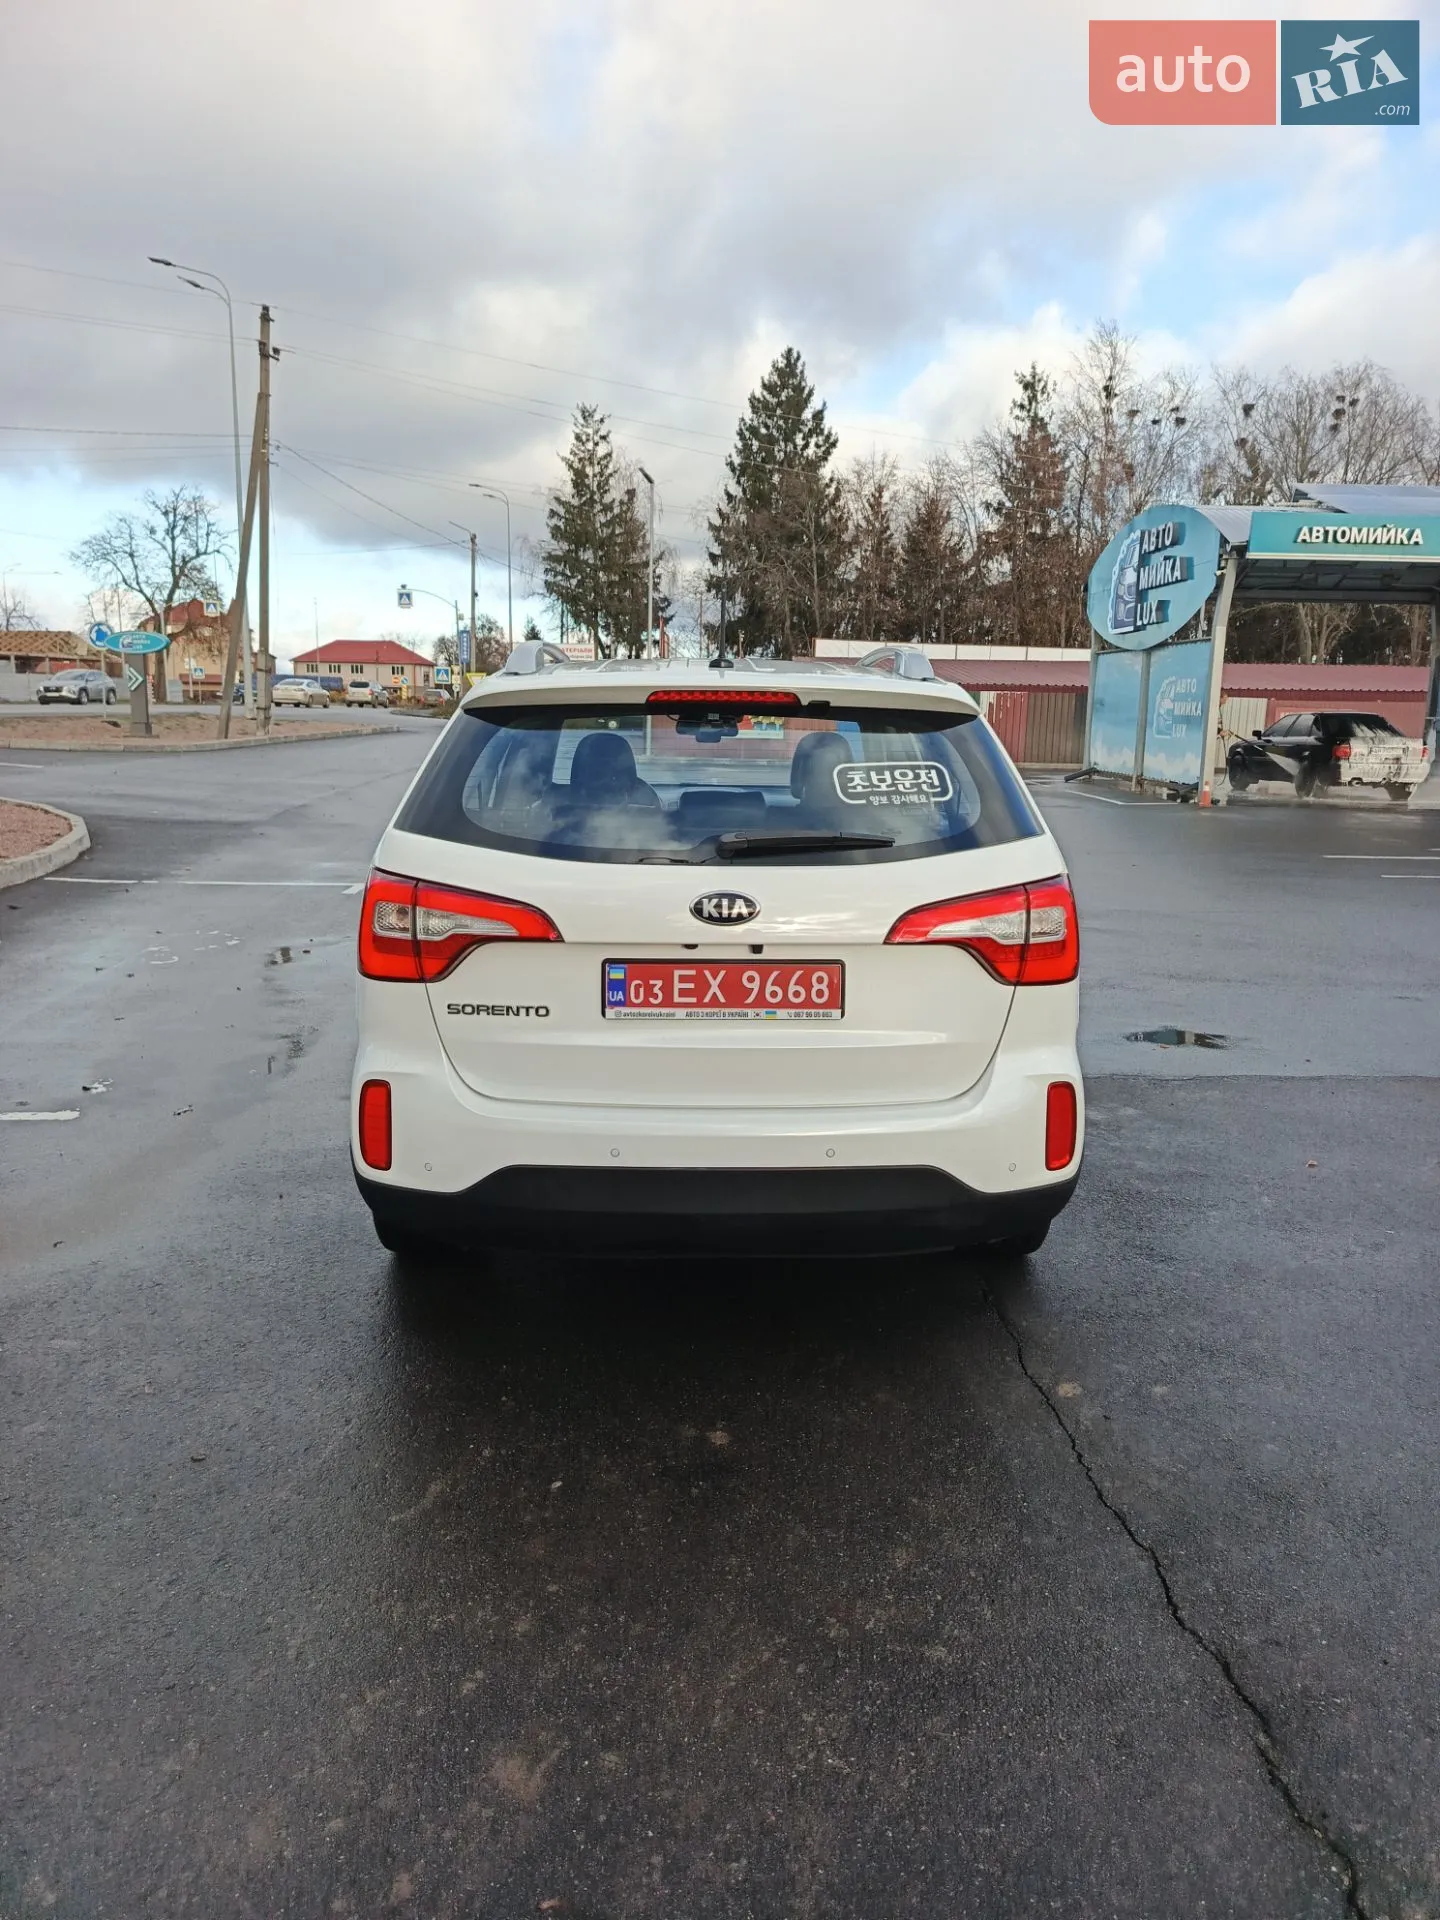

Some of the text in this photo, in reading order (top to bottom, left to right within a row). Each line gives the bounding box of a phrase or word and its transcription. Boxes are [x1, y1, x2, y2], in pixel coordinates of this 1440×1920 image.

[1141, 521, 1174, 554] АВТО
[1297, 524, 1424, 545] АВТОМИЙКА
[1139, 555, 1182, 591] МИЙКА
[1136, 601, 1159, 626] LUX
[1175, 678, 1197, 694] АВТО
[1173, 698, 1202, 717] МИЙКА
[846, 769, 941, 793] 초보운전
[701, 898, 750, 918] KIA
[609, 990, 625, 1002] UA
[629, 969, 830, 1004] 03 EX 9668
[447, 1003, 550, 1018] SORENTO
